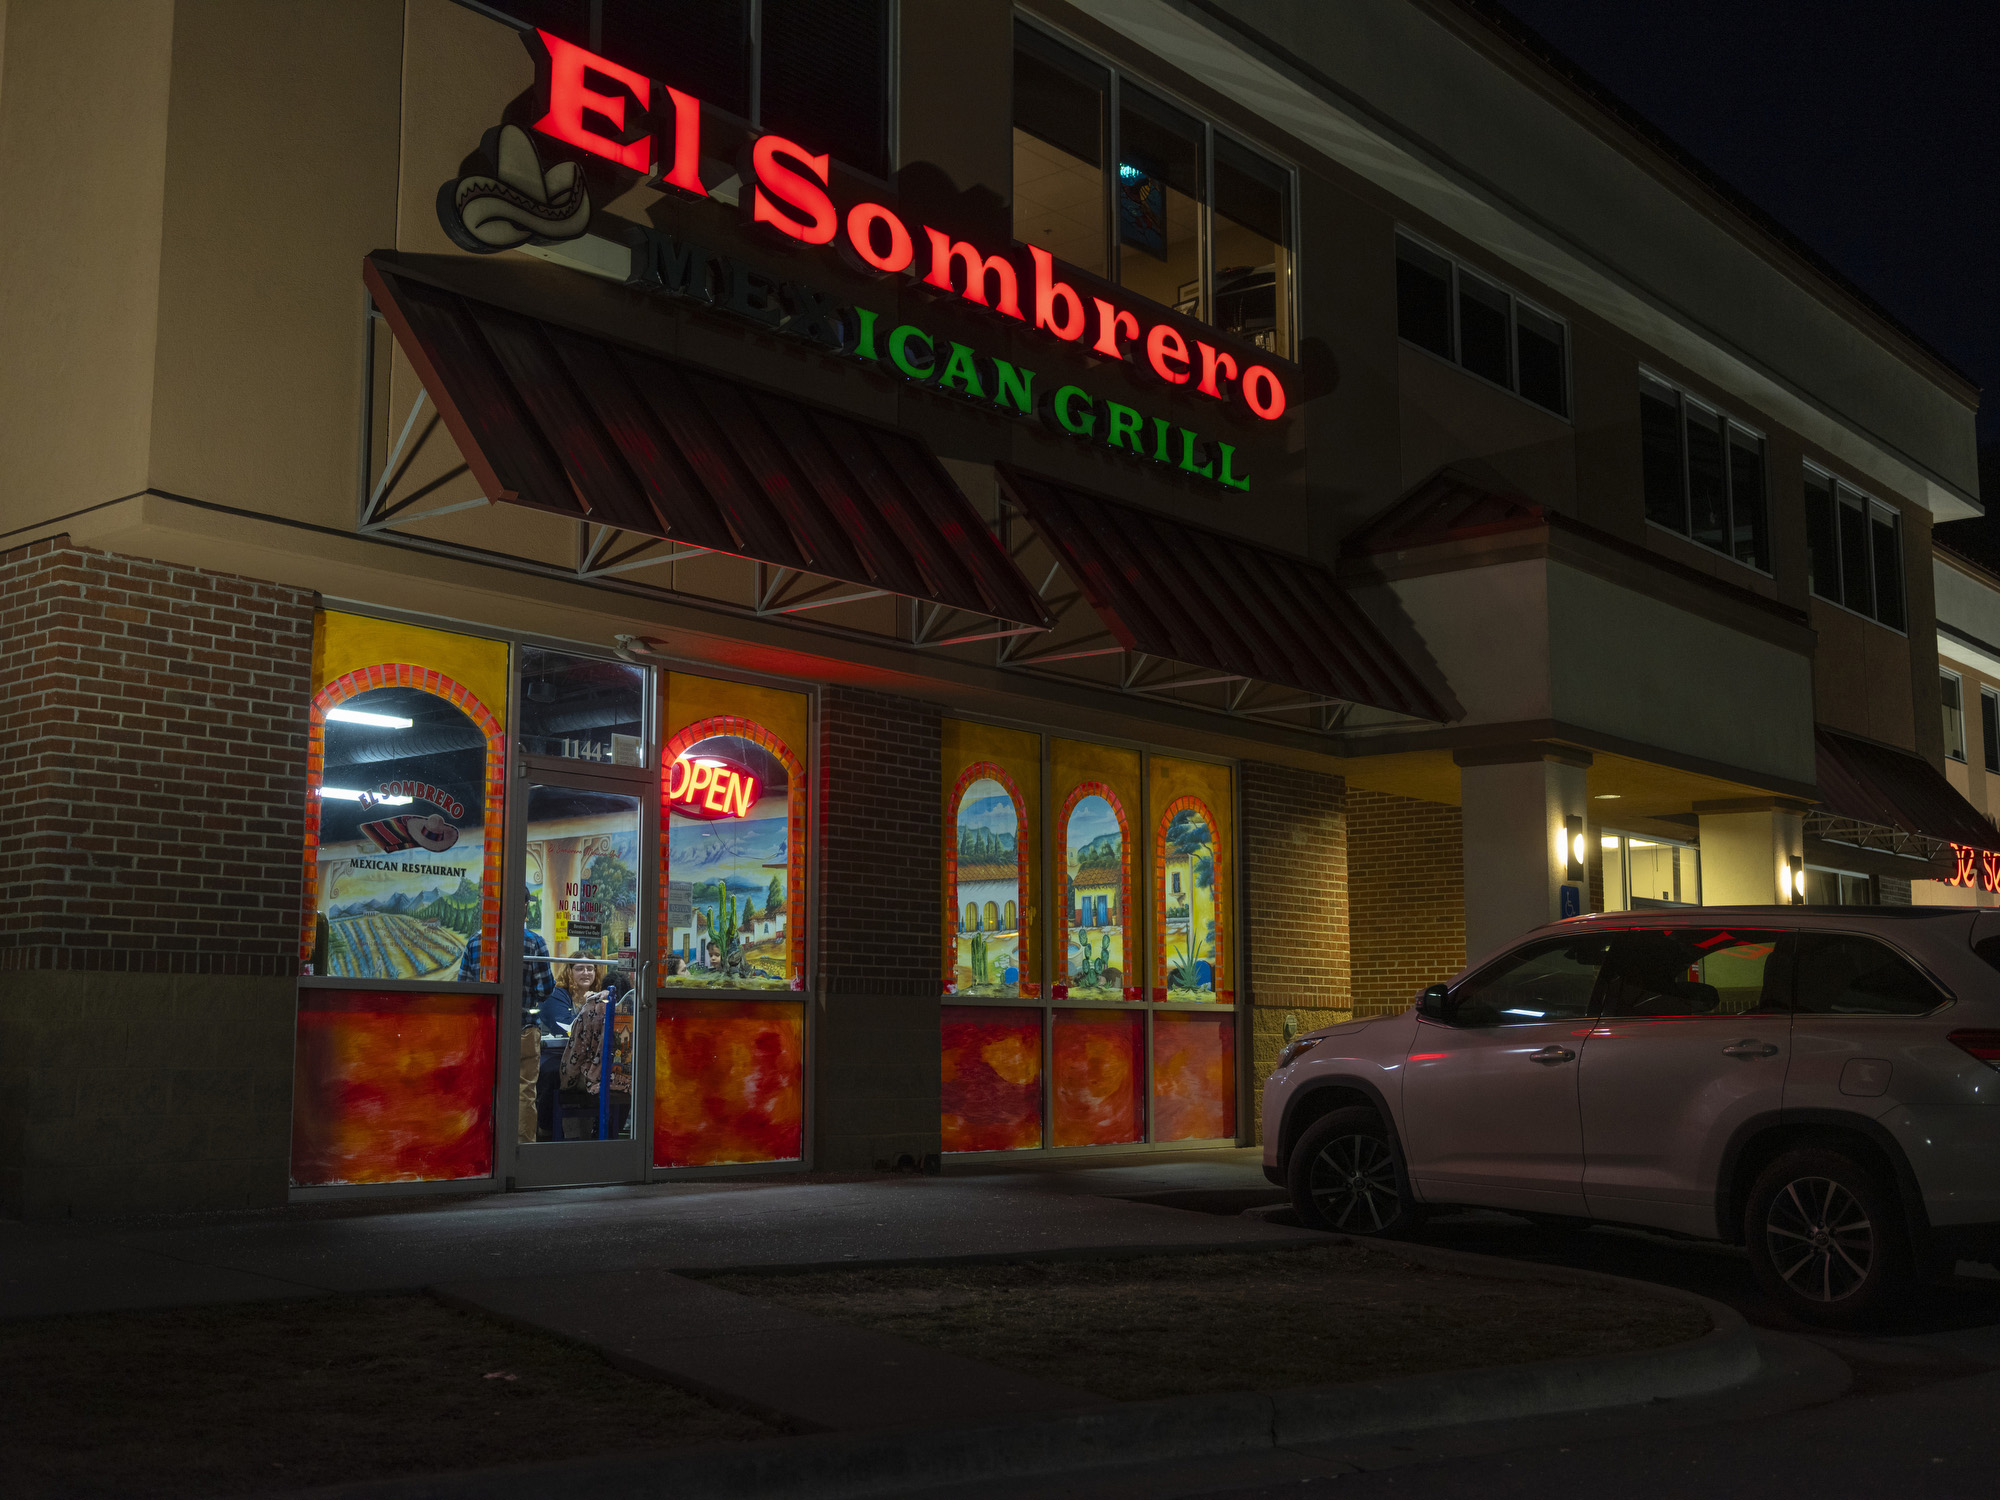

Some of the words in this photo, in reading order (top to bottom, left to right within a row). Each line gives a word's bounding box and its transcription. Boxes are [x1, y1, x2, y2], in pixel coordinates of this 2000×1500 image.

[532, 27, 709, 197] El
[753, 135, 1286, 421] Sombrero
[641, 225, 1037, 414] MEXICAN
[1054, 385, 1250, 492] GRILL
[562, 738, 602, 761] 1144
[358, 789, 379, 811] EL
[380, 780, 464, 819] SOMBRERO
[670, 757, 753, 817] OPEN
[350, 859, 398, 872] MEXICAN
[402, 863, 467, 877] RESTAURANT
[566, 882, 579, 896] NO
[582, 884, 597, 898] ID?
[559, 900, 569, 910] NO
[572, 901, 603, 913] ALCOHOL
